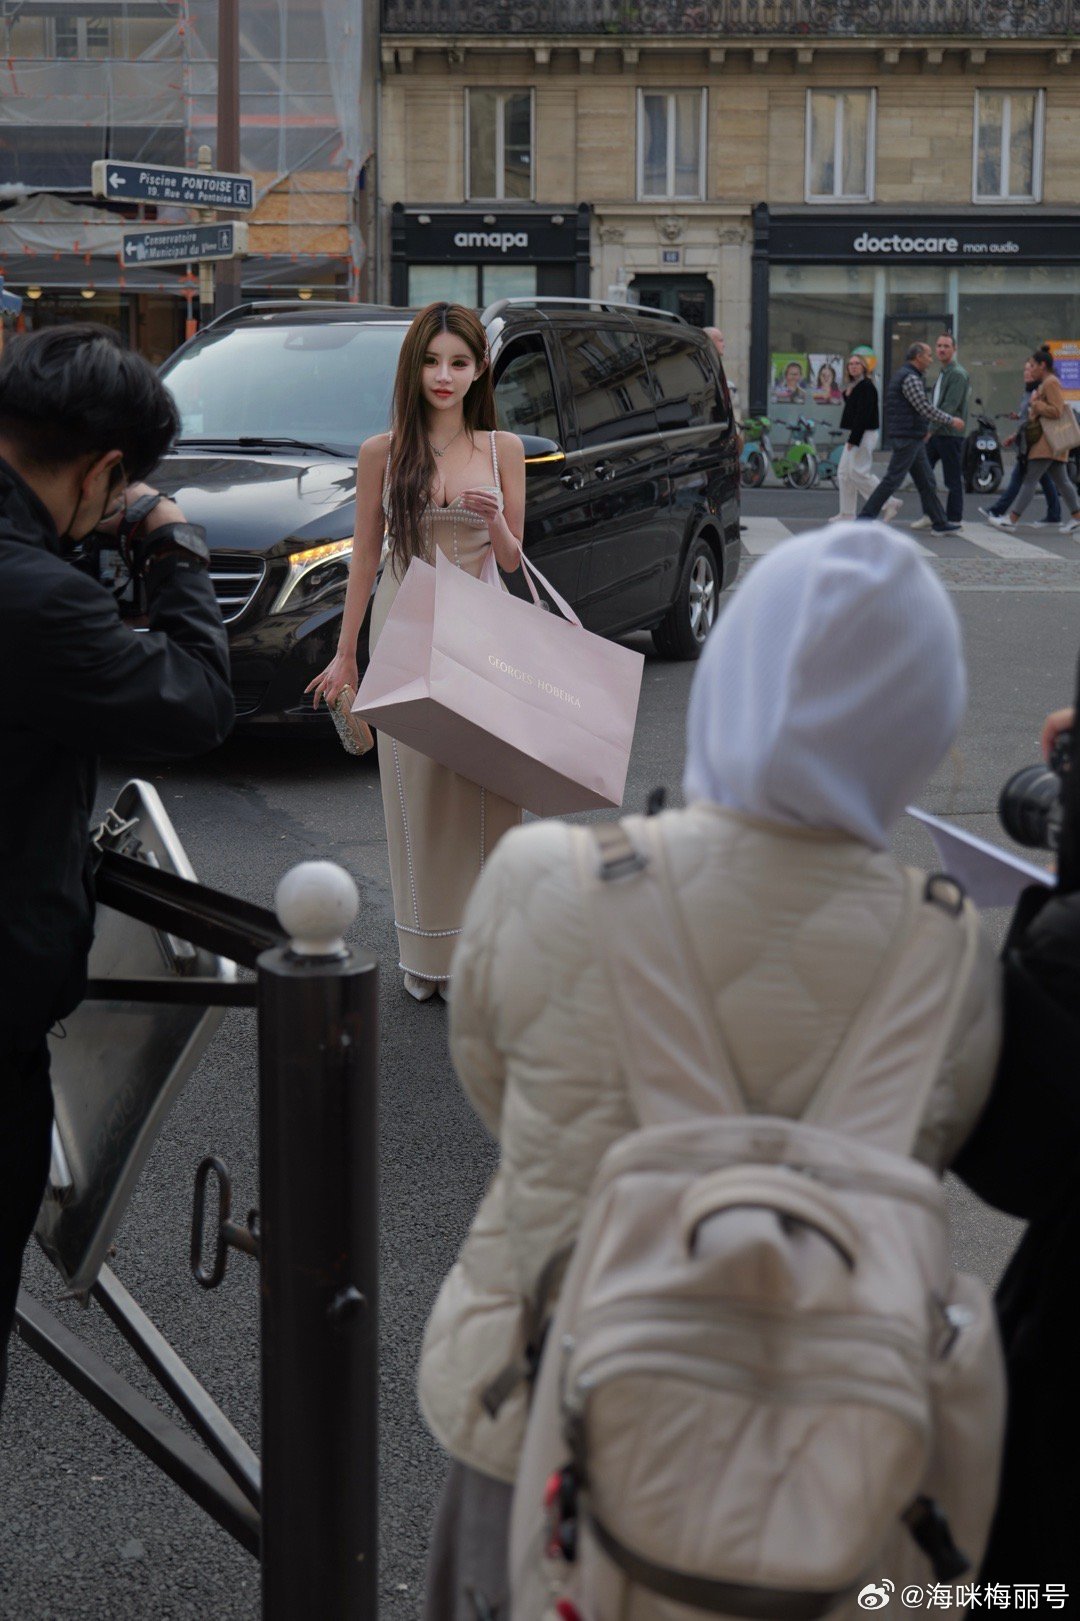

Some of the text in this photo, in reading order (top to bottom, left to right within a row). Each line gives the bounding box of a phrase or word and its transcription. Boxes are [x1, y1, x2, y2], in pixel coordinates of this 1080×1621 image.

[139, 172, 232, 193] Piscine PONTOISE
[164, 188, 180, 199] Rue
[184, 190, 195, 200] de
[198, 191, 232, 203] Pontoise
[144, 232, 197, 246] Conservatoire
[454, 232, 528, 252] amapa
[853, 232, 1019, 253] doctocare mon audio
[148, 245, 187, 259] Municipal
[189, 244, 200, 255] du
[488, 655, 534, 685] GEORGES
